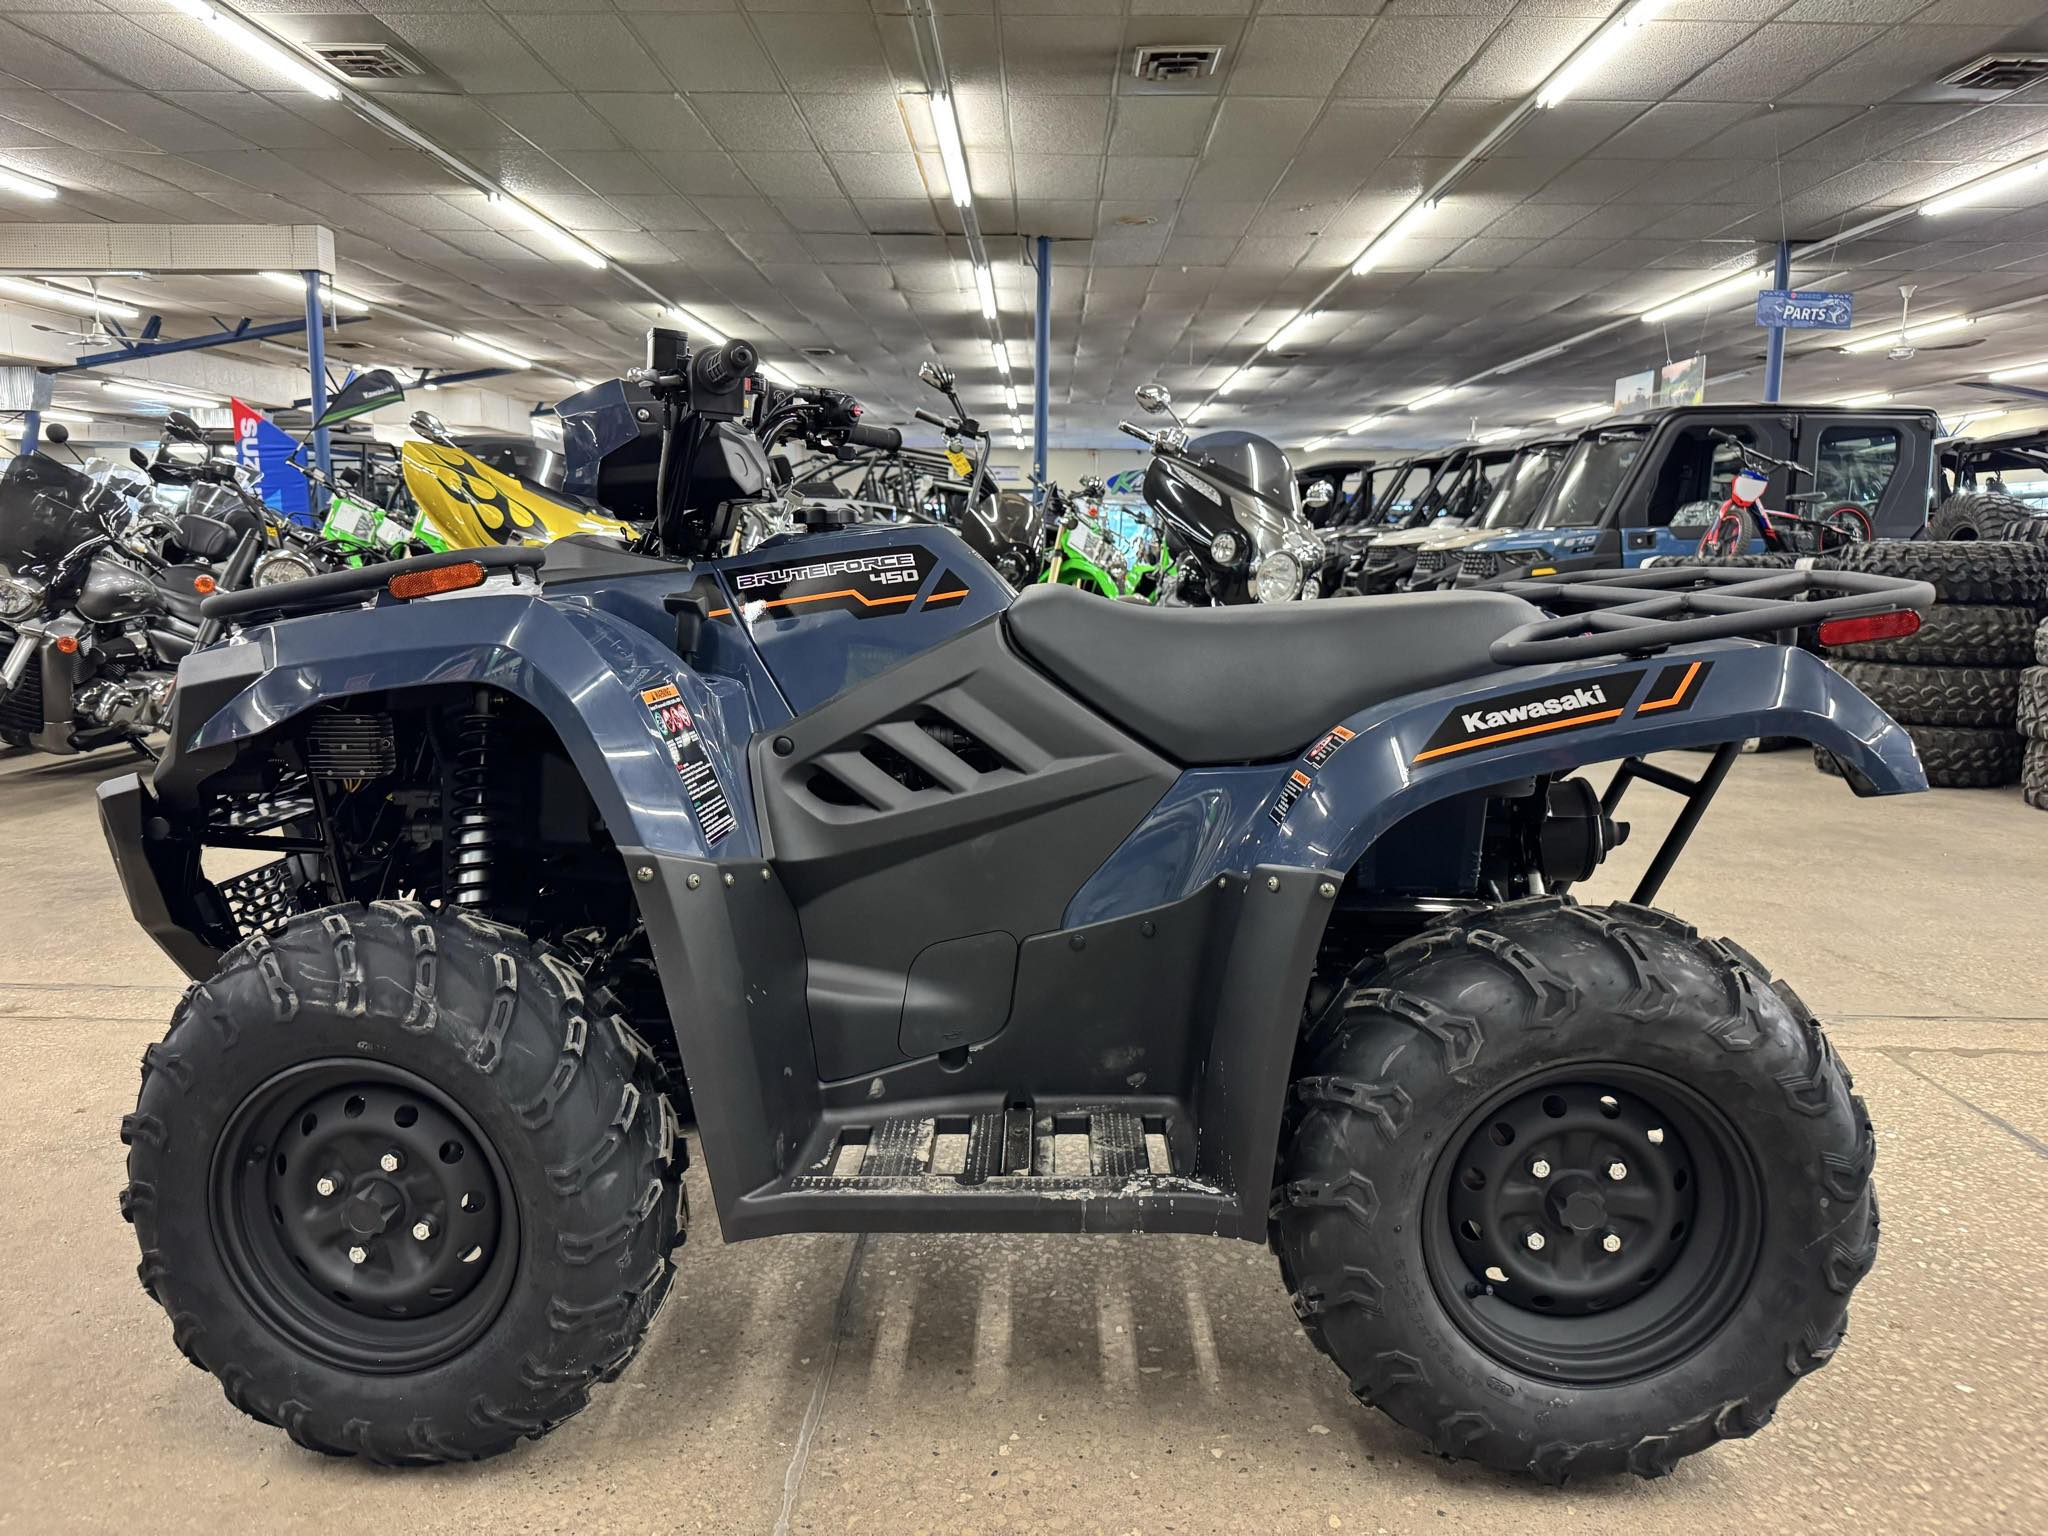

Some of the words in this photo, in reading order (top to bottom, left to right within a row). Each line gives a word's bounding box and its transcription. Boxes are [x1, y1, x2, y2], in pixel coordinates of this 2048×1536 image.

[1783, 305, 1827, 321] PARTS
[240, 417, 262, 499] SUZ
[736, 563, 826, 590] BRUTE
[827, 553, 916, 576] FORCE
[869, 569, 919, 585] 450
[1461, 684, 1607, 733] Kawasaki
